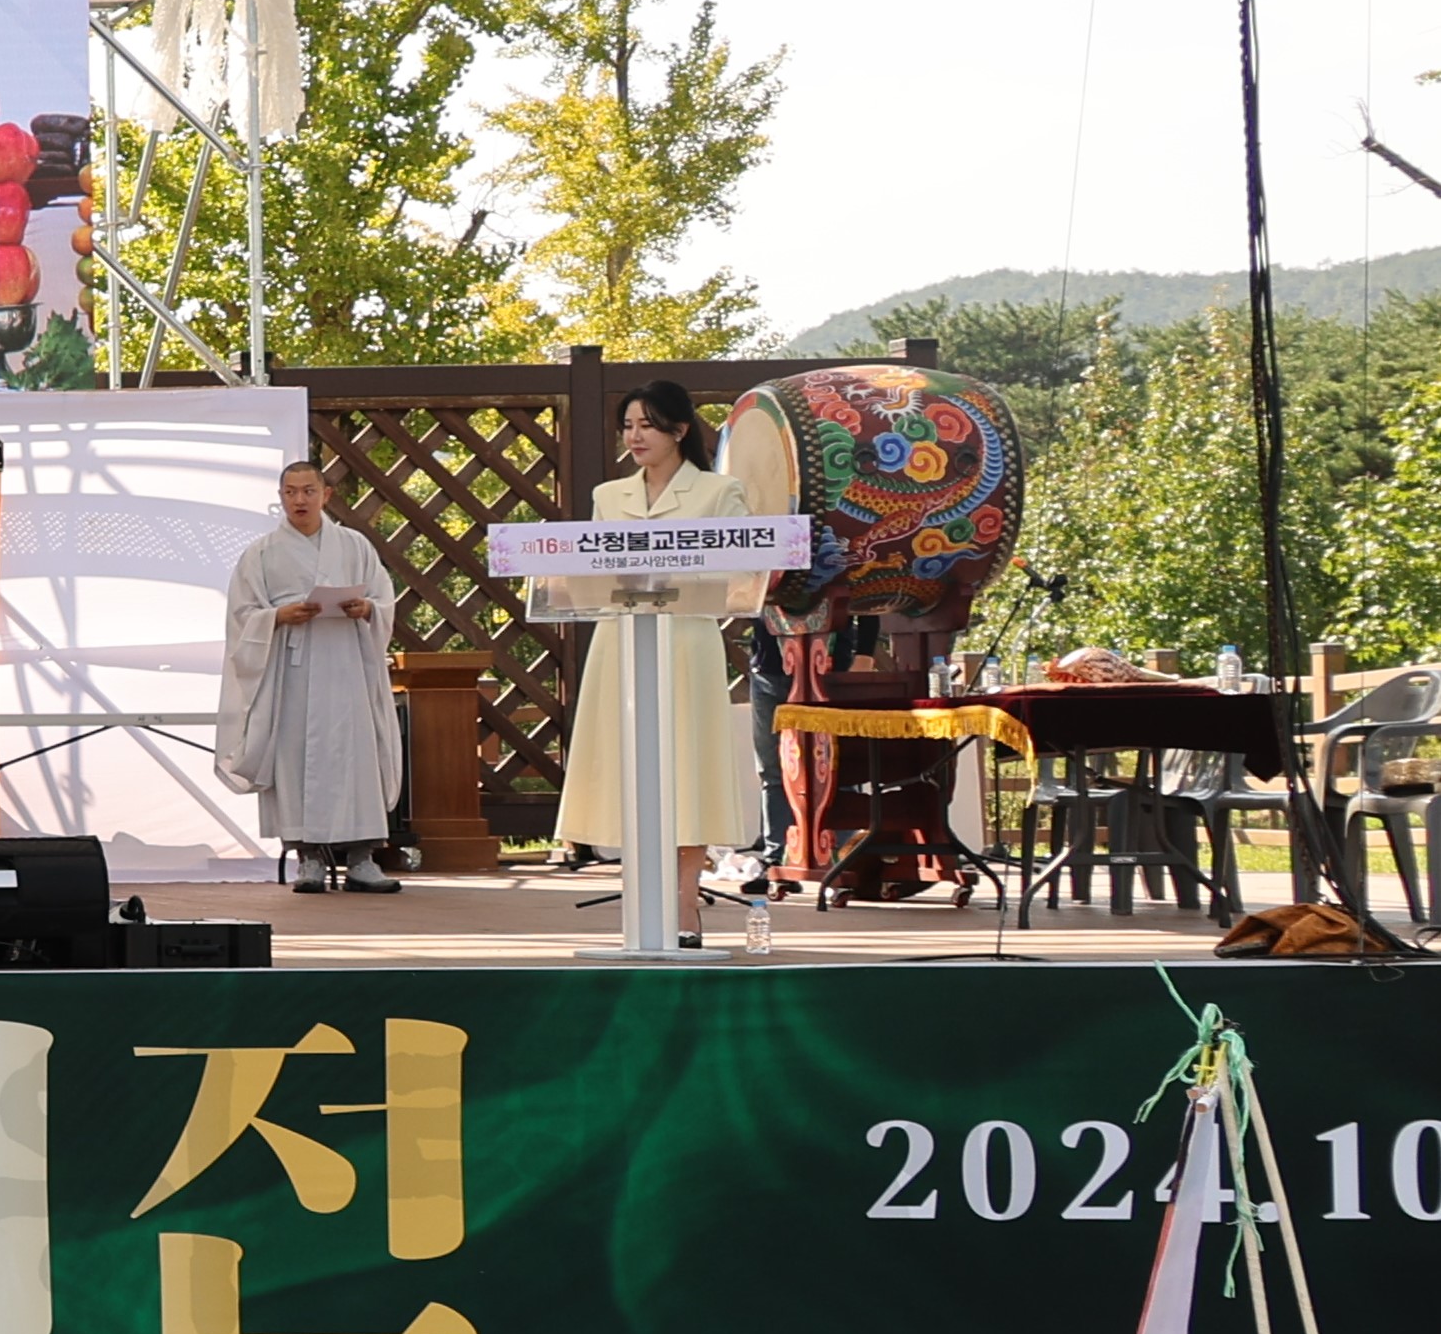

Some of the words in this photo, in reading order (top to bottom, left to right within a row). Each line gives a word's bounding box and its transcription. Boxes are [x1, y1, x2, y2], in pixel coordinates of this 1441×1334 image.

[523, 538, 573, 554] 제16회
[578, 528, 774, 552] 산청불교문화제전
[590, 555, 705, 569] 산청불교사암연합회
